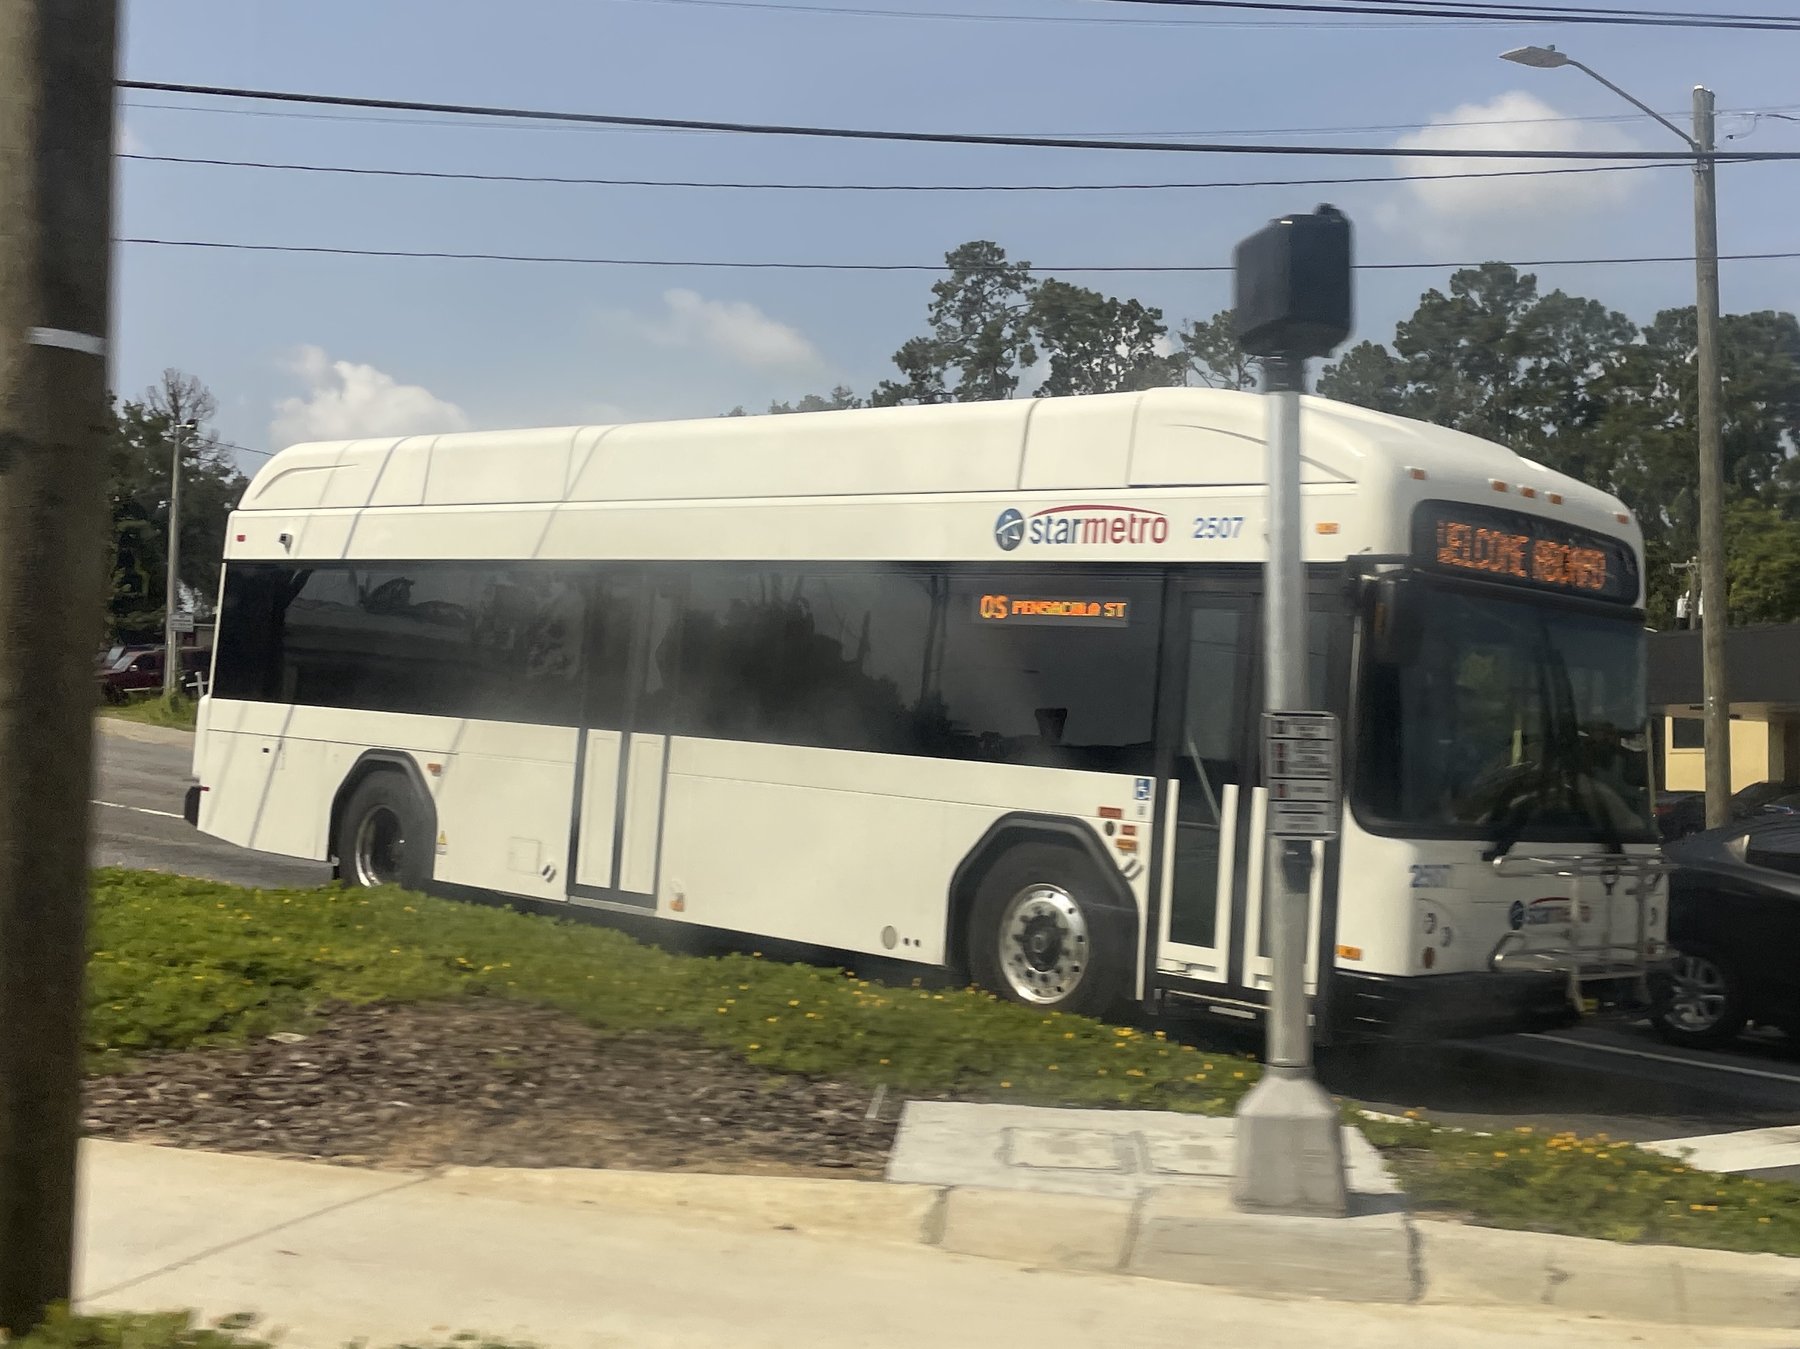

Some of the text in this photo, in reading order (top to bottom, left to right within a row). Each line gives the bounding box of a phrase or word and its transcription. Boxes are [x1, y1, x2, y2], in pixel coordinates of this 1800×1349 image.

[1029, 513, 1169, 545] starmetro
[1192, 516, 1245, 539] 2507
[1103, 601, 1128, 618] ST
